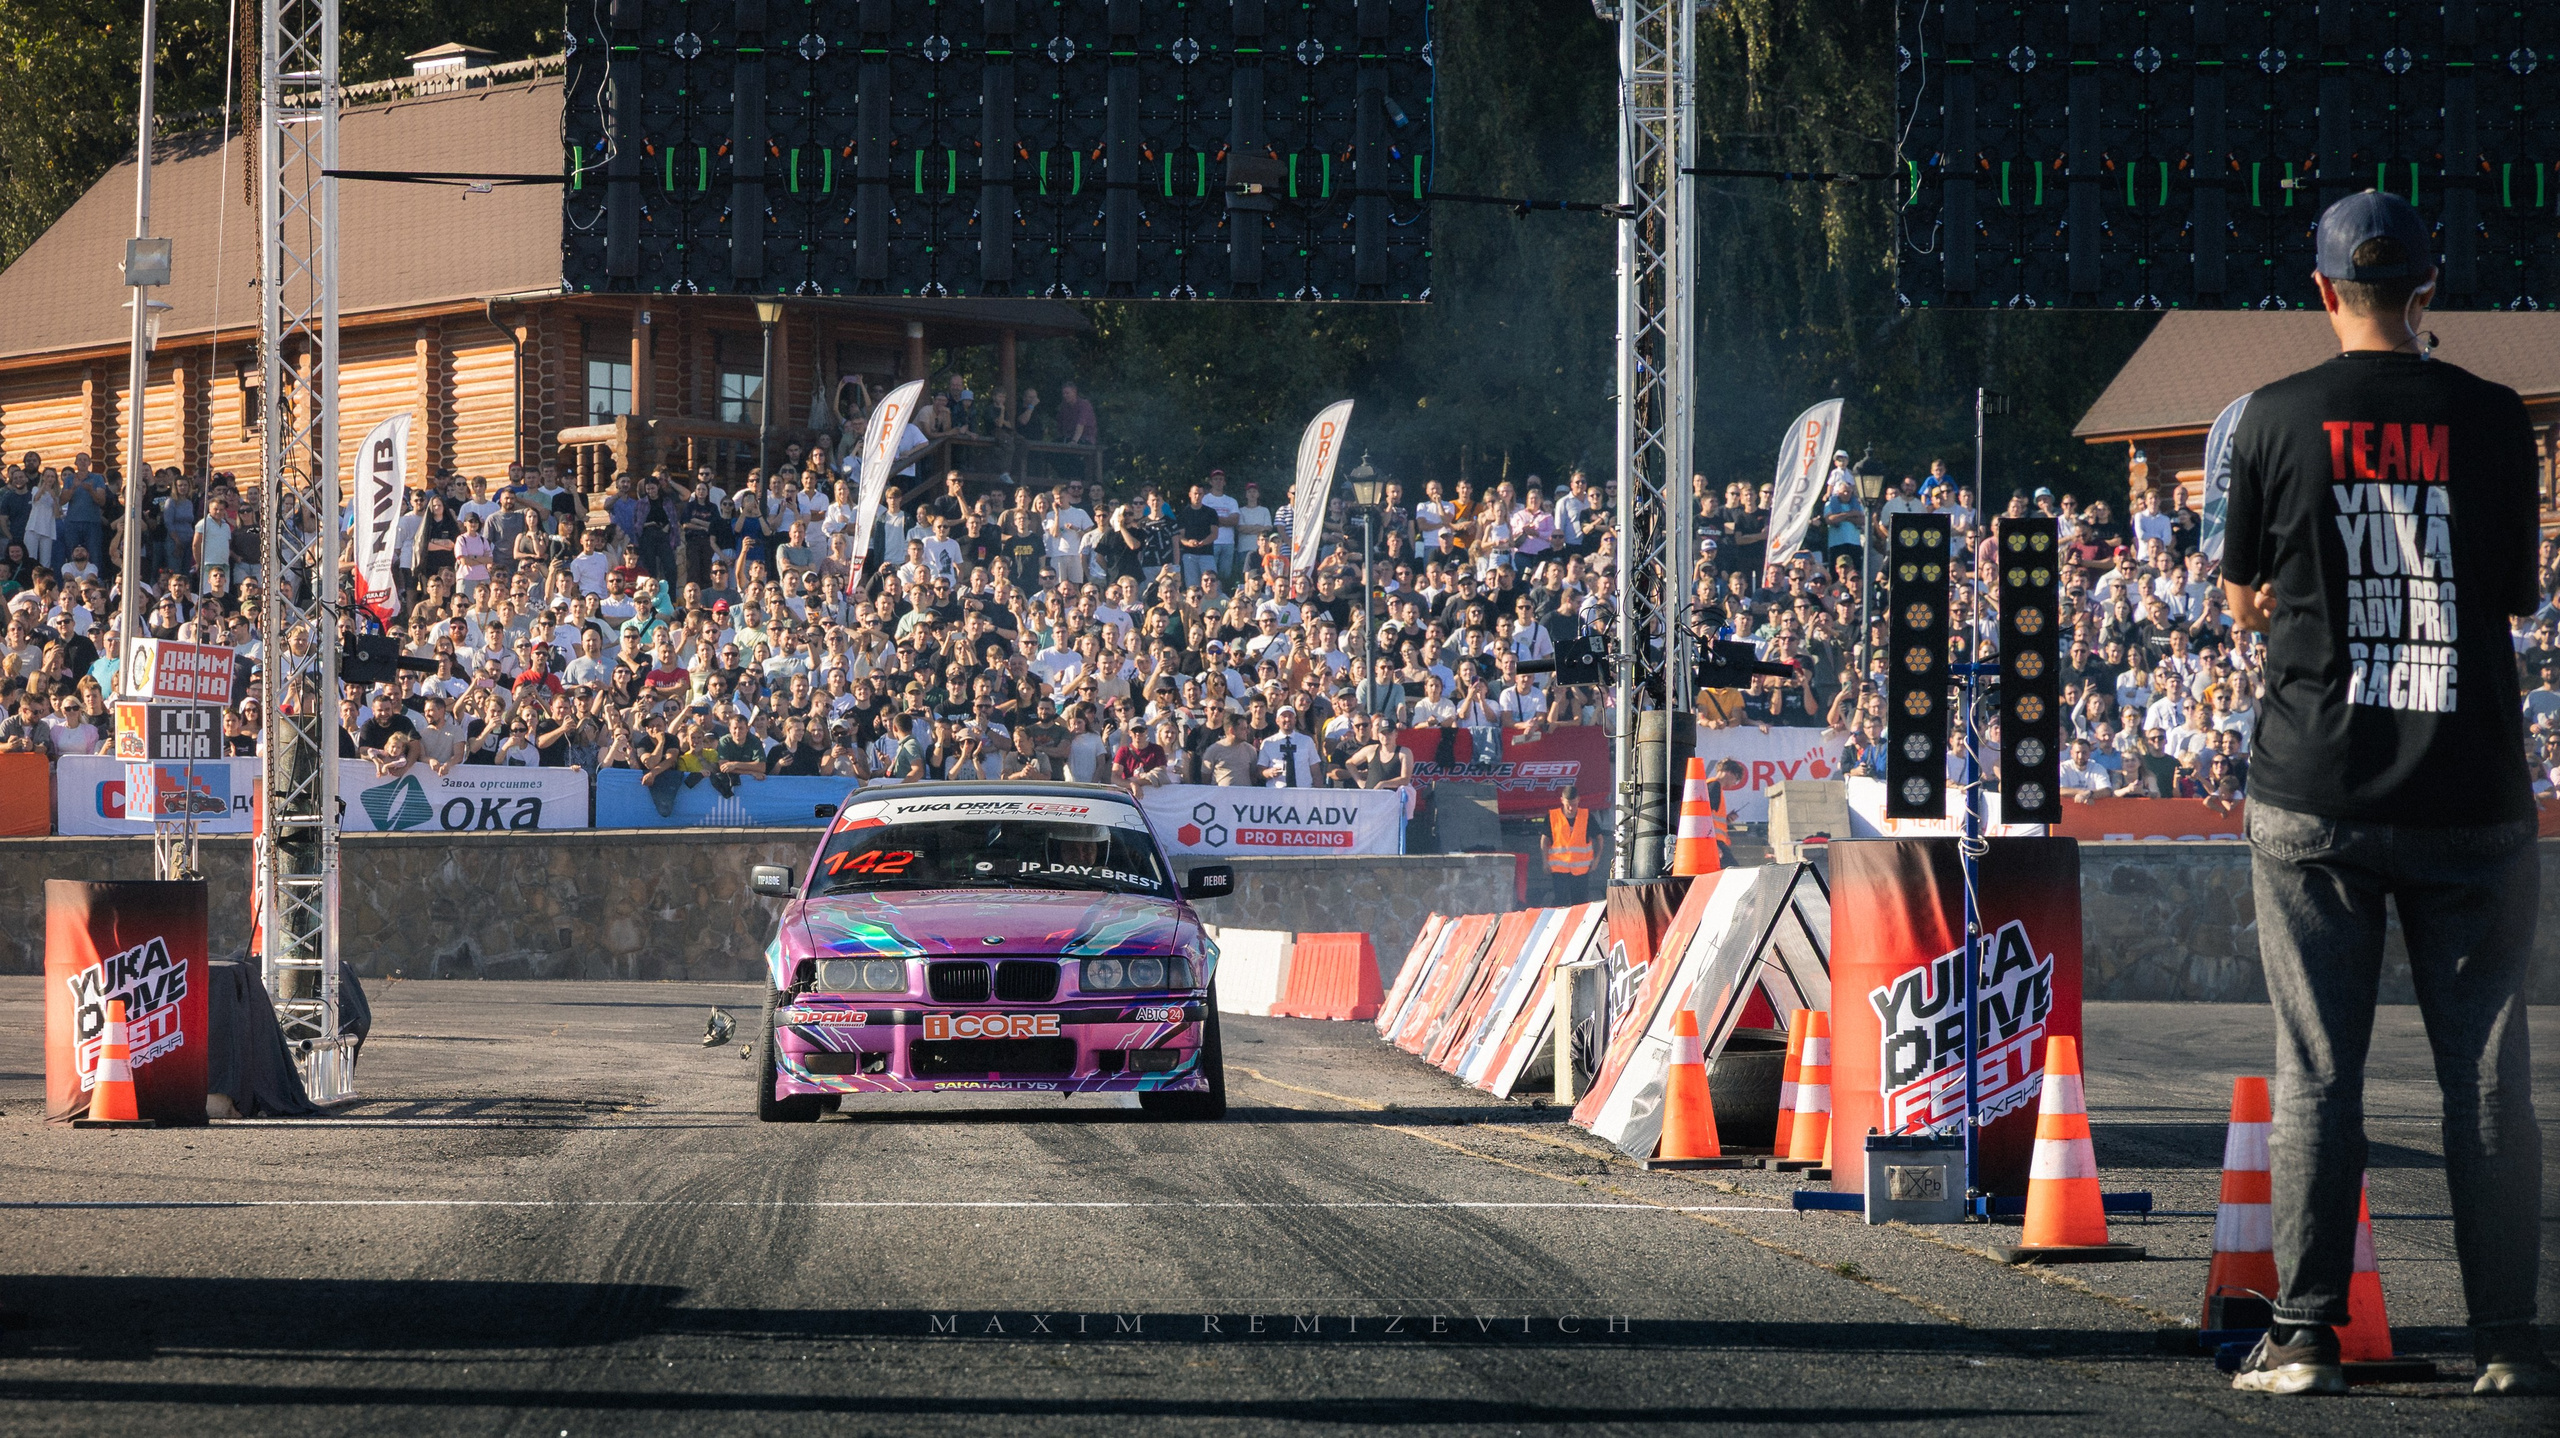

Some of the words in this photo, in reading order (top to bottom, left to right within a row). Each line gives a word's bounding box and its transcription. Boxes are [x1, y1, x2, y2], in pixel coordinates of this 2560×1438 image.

[643, 311, 651, 324] 5
[1316, 421, 1335, 476] DRY
[1803, 420, 1821, 475] DRY
[2322, 421, 2450, 481] TEAM
[372, 437, 394, 554] NVB
[2335, 513, 2454, 579] YUKA
[161, 650, 230, 674] ДЖИМ
[159, 672, 226, 696] ХАНА
[2346, 659, 2458, 712] RACING
[161, 710, 210, 732] ГО
[161, 735, 210, 757] НКА
[1520, 763, 1576, 776] FEST
[441, 778, 476, 789] Завод
[480, 780, 543, 789] оргсинтез
[897, 803, 951, 814] YUKA
[954, 802, 1023, 810] DRIVE
[1028, 802, 1089, 813] FEST
[1233, 804, 1301, 825] YUKA
[1306, 806, 1358, 825] ADV
[1244, 831, 1276, 844] PRO
[1282, 832, 1344, 846] RACING
[824, 850, 914, 875] 142
[757, 875, 780, 886] ПРАВОЕ
[1018, 861, 1162, 891] JP_DAY_BREST
[1203, 874, 1227, 887] ЛЕВОЕ
[71, 939, 170, 1007] YUKA
[1874, 924, 2034, 1038] YUKA
[793, 1011, 867, 1023] ДРАЙВ
[1885, 955, 2051, 1093] DRIVE
[82, 1006, 174, 1073] FST
[1016, 1081, 1058, 1090] ГУБУ
[1924, 1178, 1941, 1191] Pb
